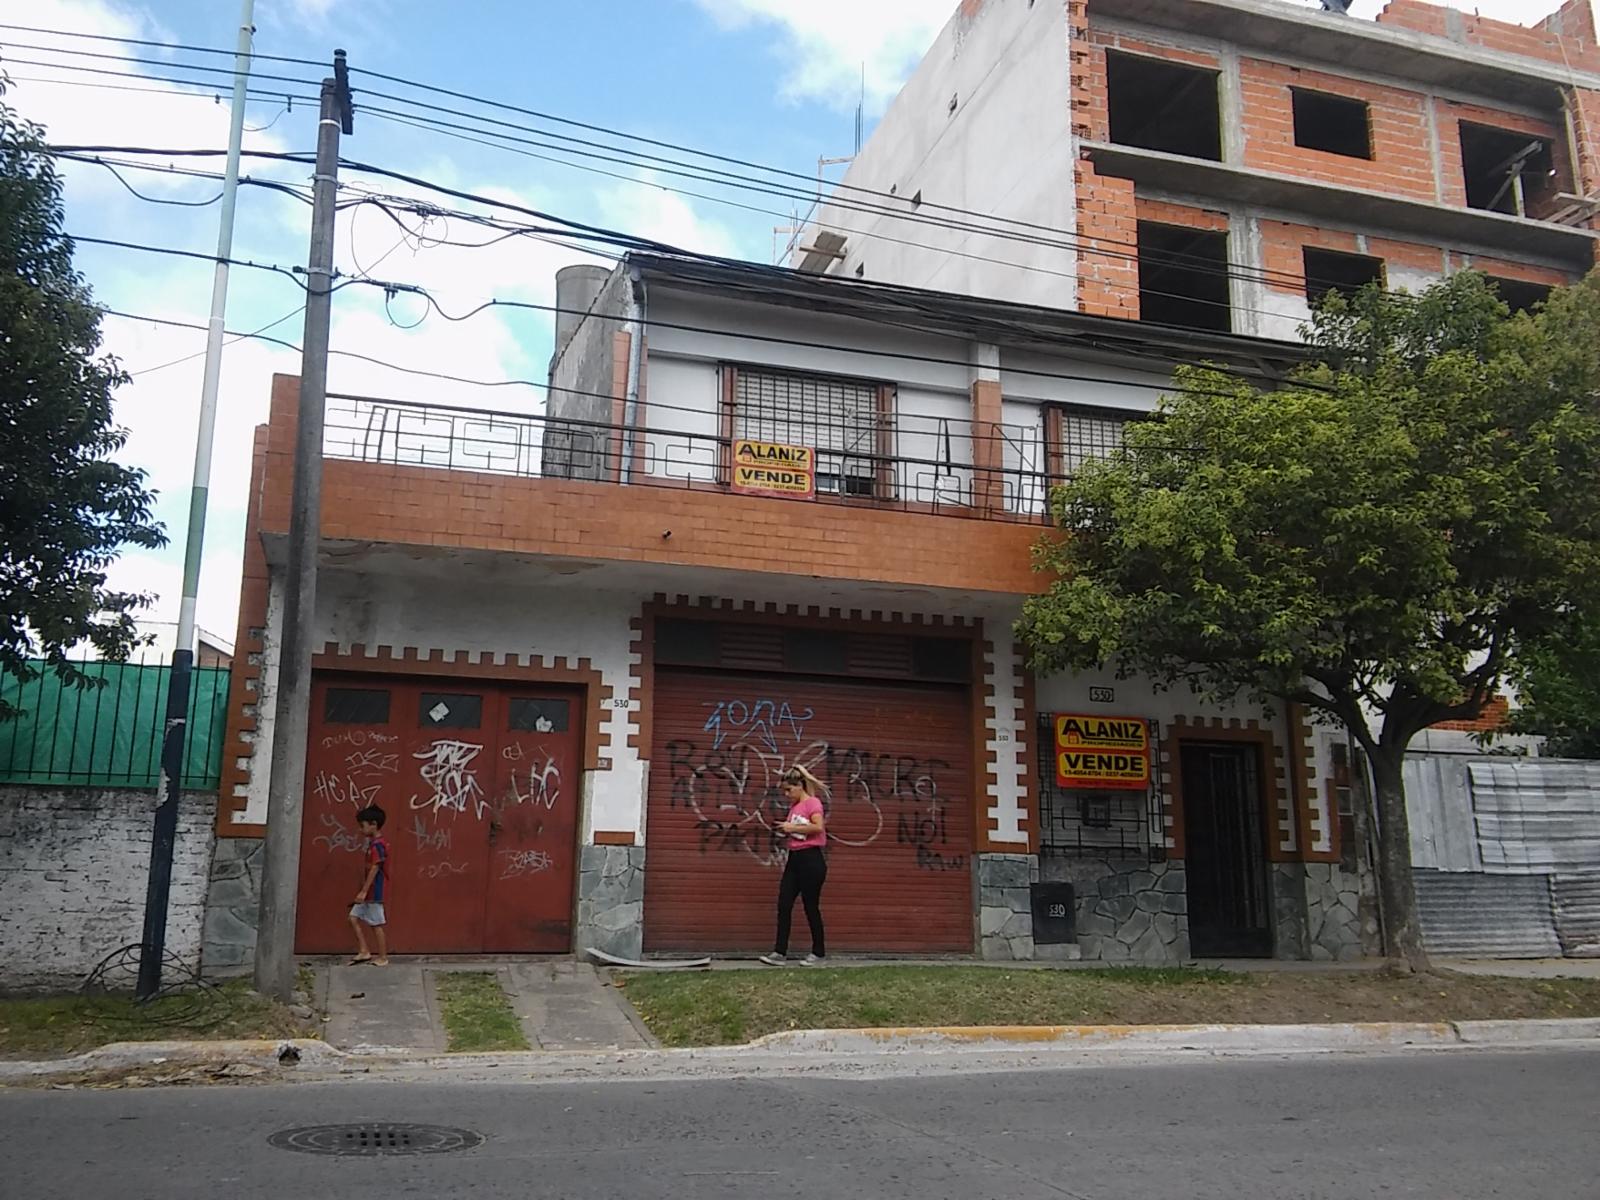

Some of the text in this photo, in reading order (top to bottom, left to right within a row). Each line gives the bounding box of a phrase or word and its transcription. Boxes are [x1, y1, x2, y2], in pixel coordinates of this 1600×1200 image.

[738, 443, 807, 462] ALANIZ
[741, 468, 806, 485] VENDE
[614, 700, 629, 708] 530
[1094, 690, 1111, 701] 530
[1062, 718, 1143, 740] ALANIZ
[1064, 753, 1143, 771] VENDE
[1049, 903, 1066, 916] 530
